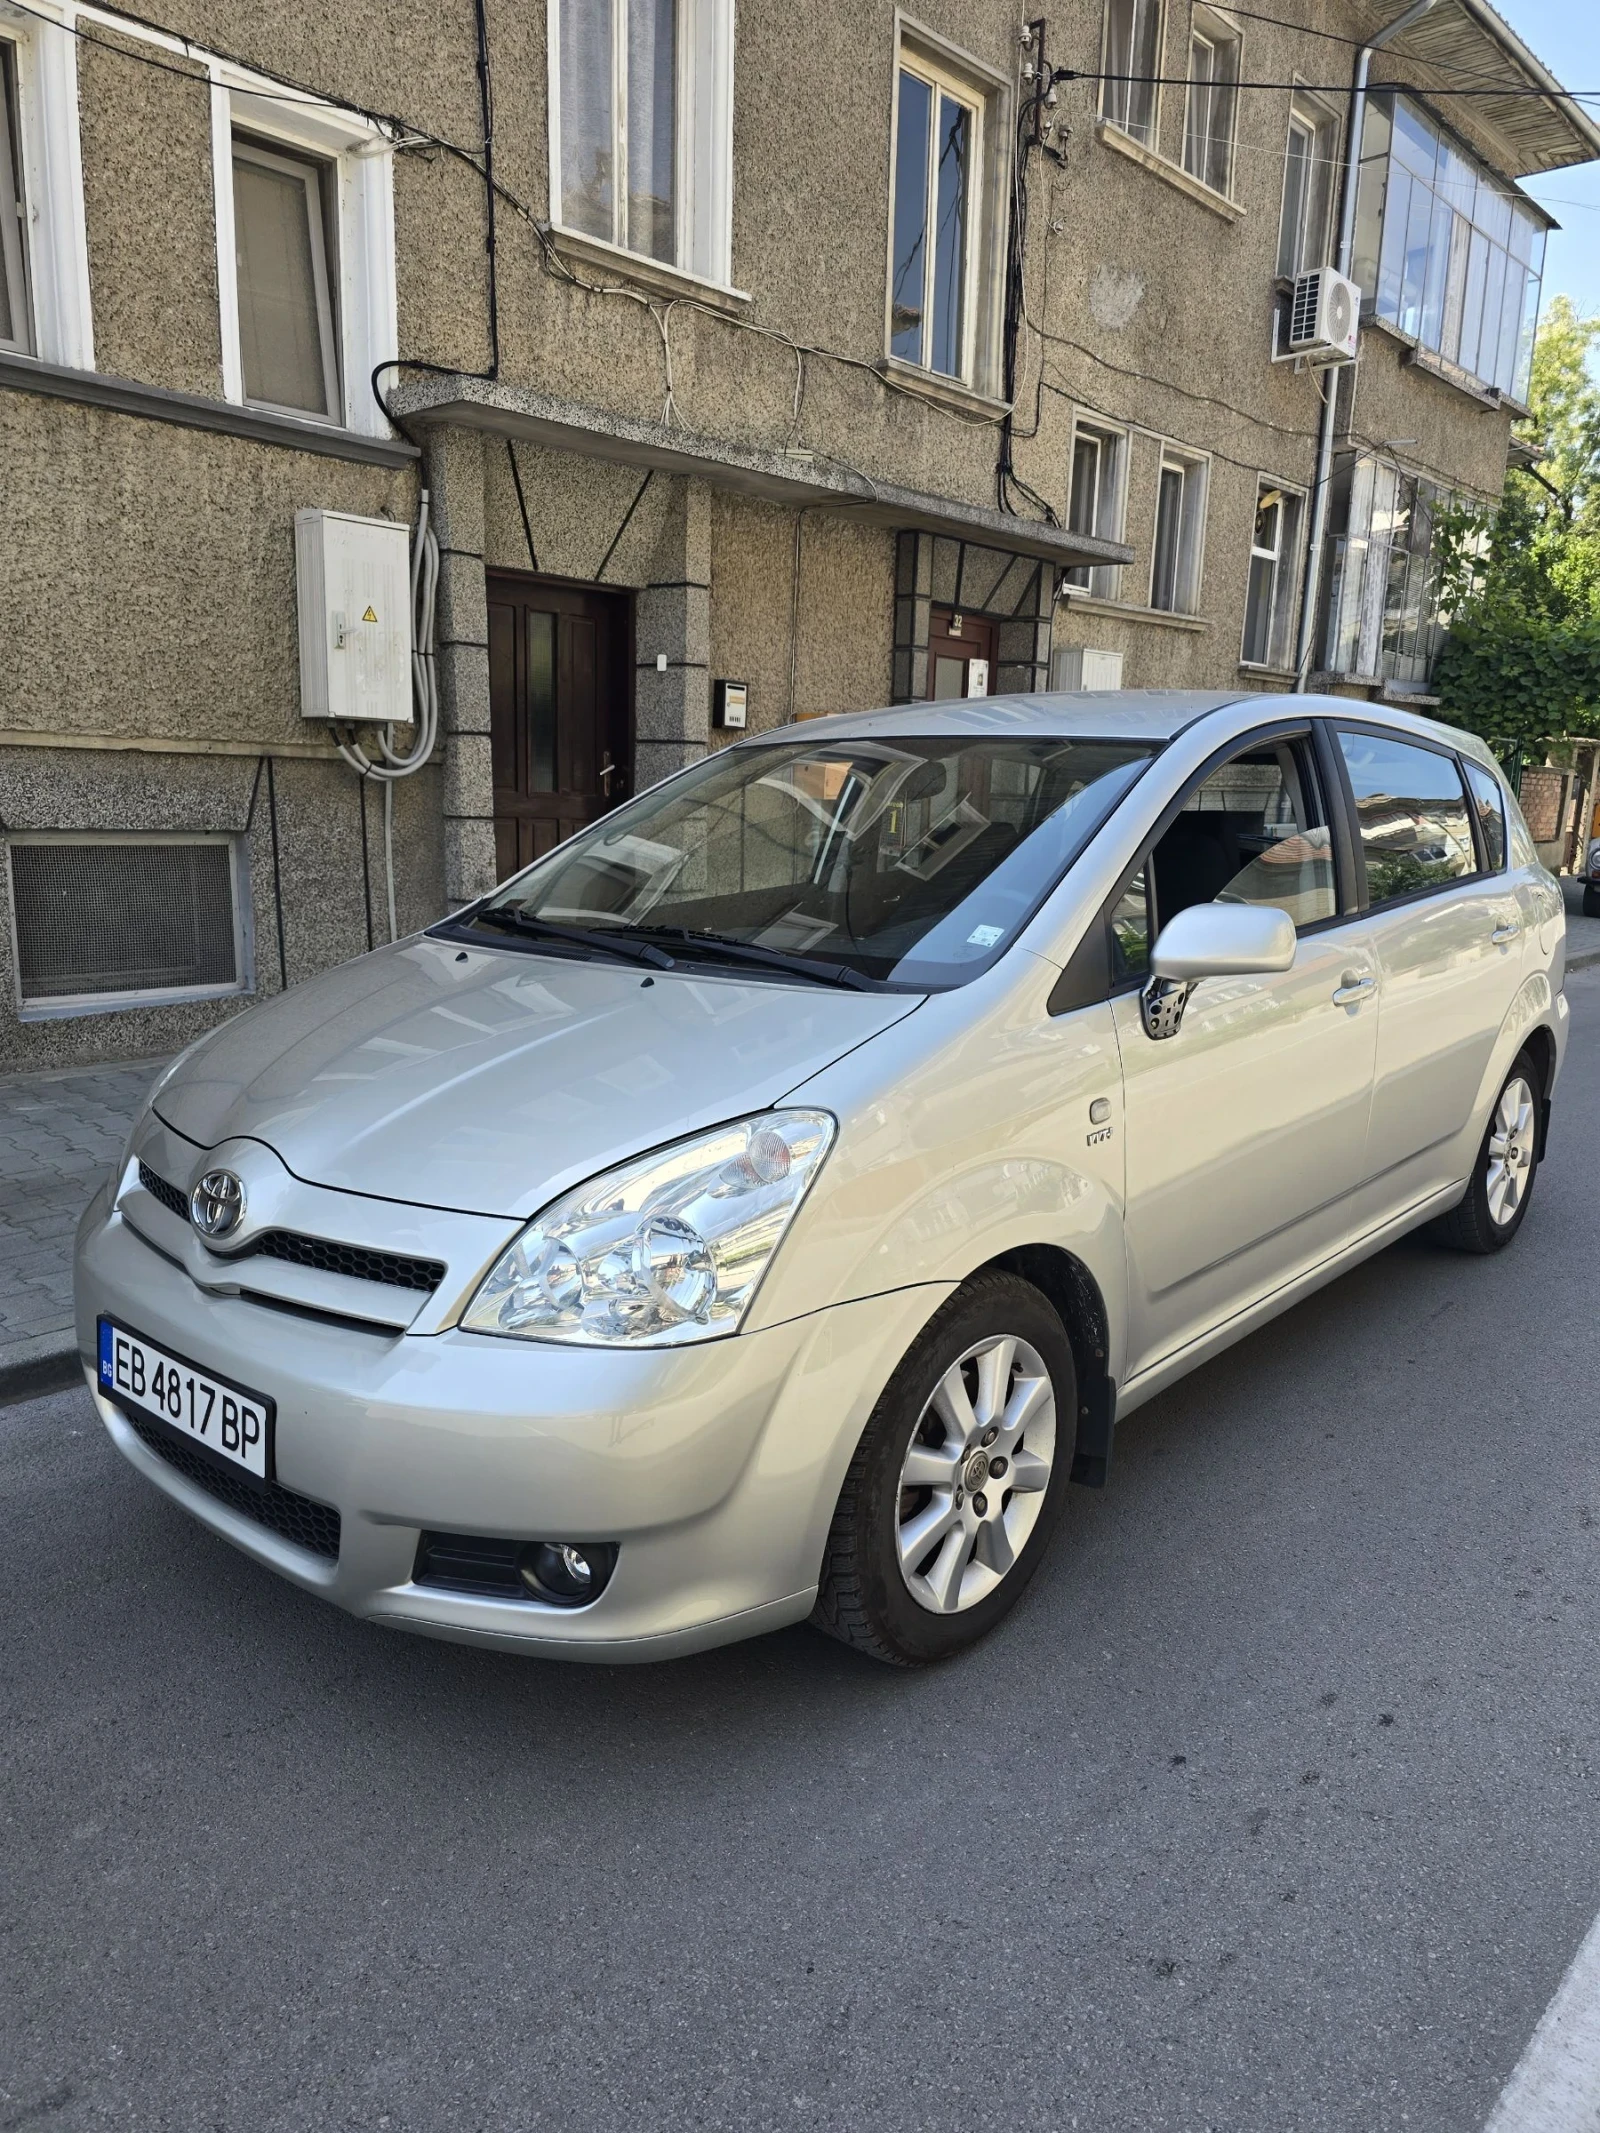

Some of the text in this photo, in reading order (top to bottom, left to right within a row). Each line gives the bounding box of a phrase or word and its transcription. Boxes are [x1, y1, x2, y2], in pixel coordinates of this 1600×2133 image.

[954, 614, 963, 628] 32
[102, 1359, 113, 1378] BG
[116, 1337, 260, 1459] EB 4817 BP
